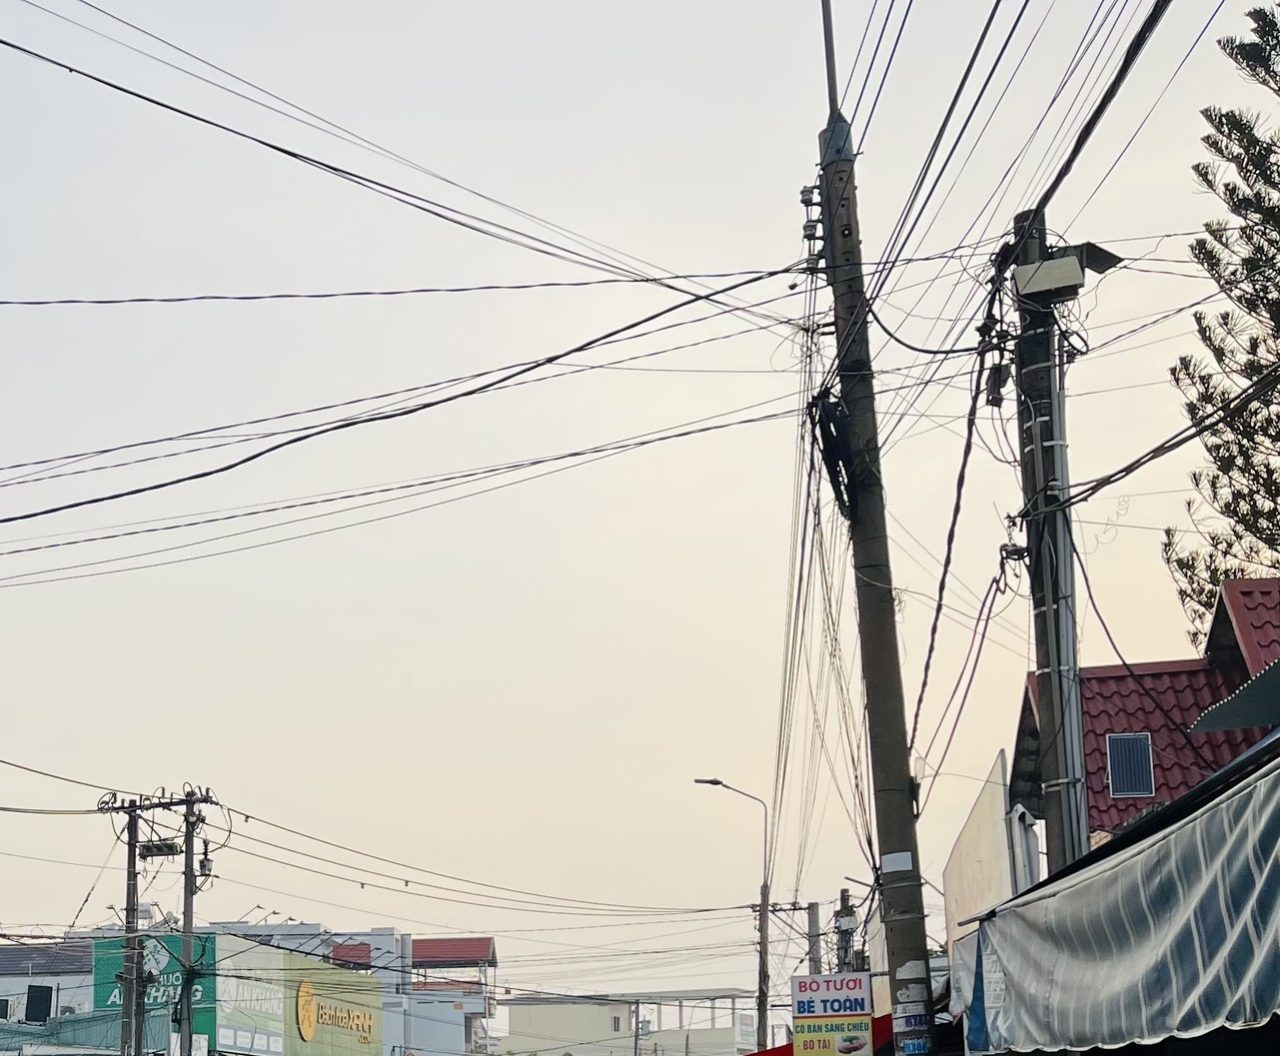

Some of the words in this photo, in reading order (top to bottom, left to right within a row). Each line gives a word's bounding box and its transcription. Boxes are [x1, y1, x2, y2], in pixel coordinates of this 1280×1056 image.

[798, 977, 820, 993] BÒ
[823, 977, 862, 992] TƯƠI
[820, 995, 865, 1013] TOÀN
